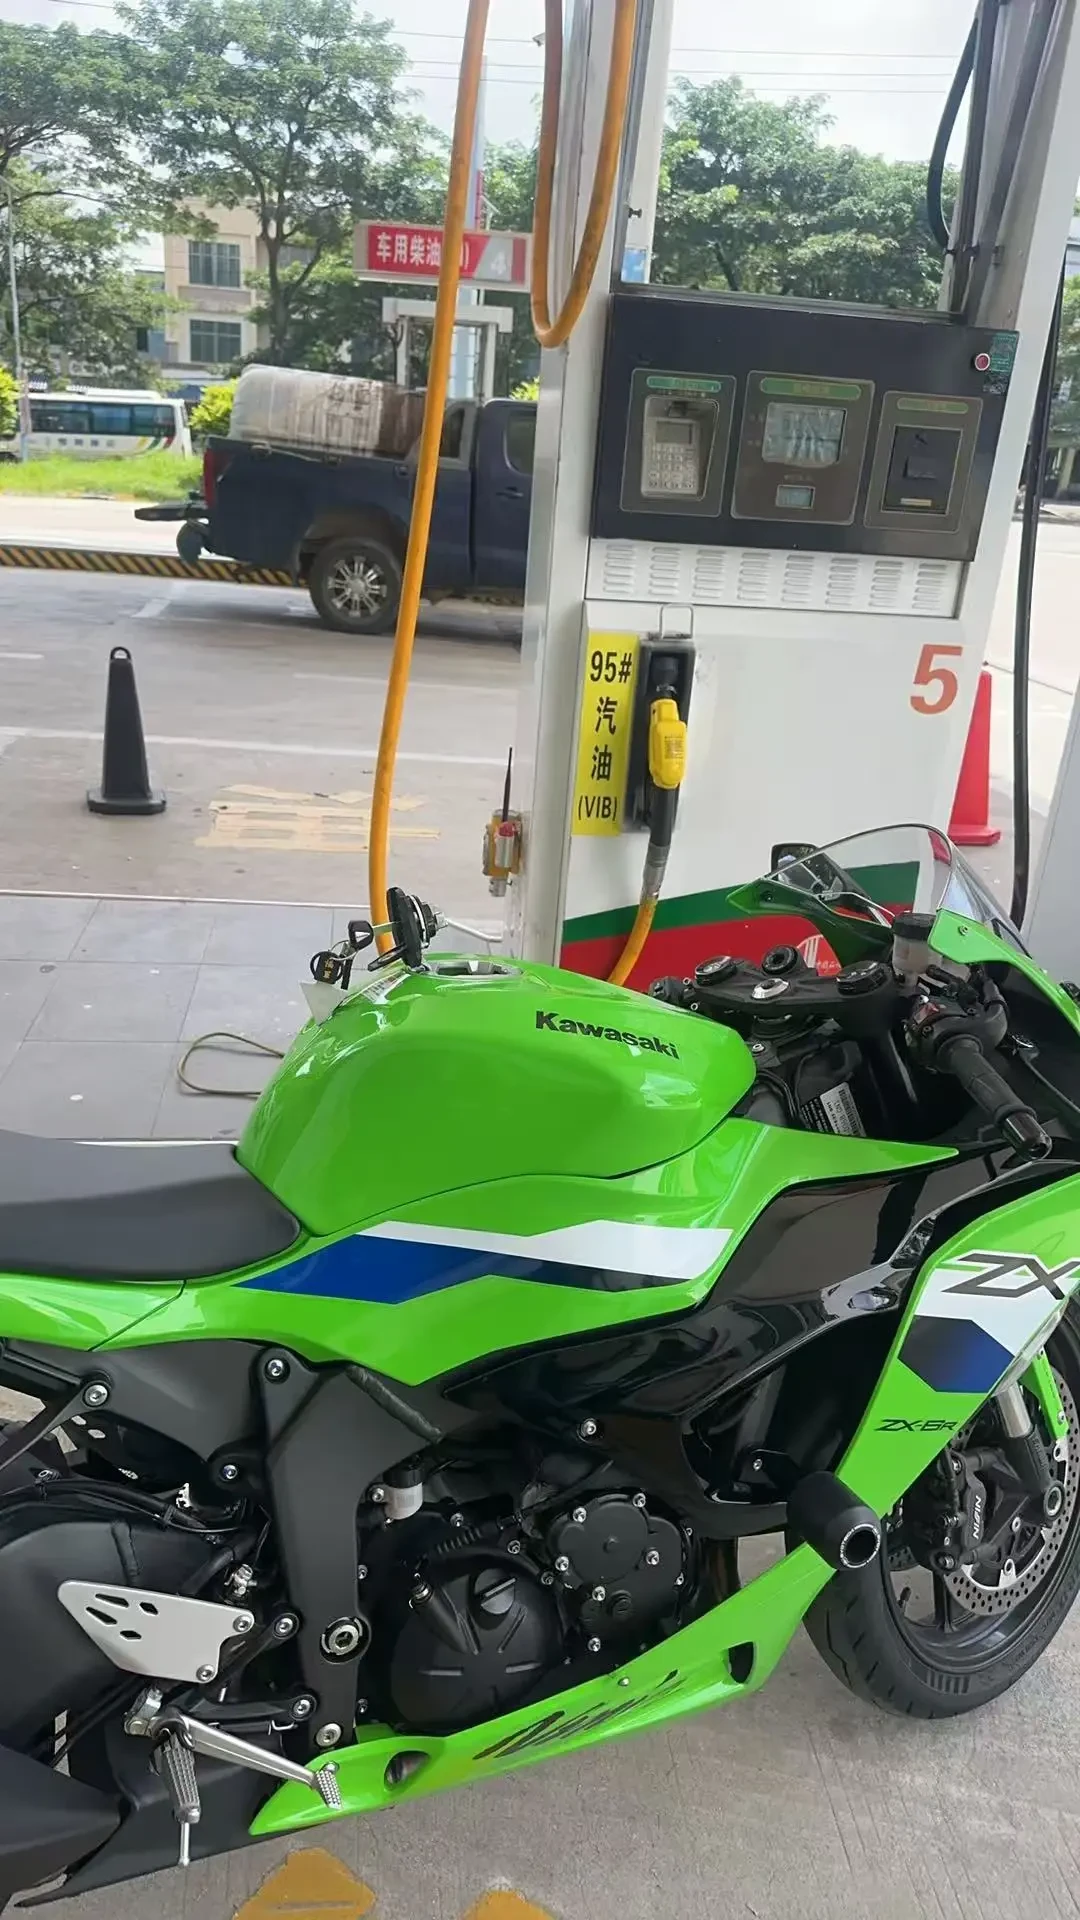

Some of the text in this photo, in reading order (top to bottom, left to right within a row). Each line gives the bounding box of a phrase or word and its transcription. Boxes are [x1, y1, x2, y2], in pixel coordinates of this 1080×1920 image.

[376, 231, 441, 267] 车用柴油
[490, 251, 508, 275] 4
[589, 650, 632, 684] 95#
[910, 643, 963, 715] 5
[578, 795, 619, 821] (VIB)
[535, 1010, 680, 1060] Kawasaki
[940, 1253, 1080, 1300] ZX
[874, 1418, 957, 1431] ZX-6R
